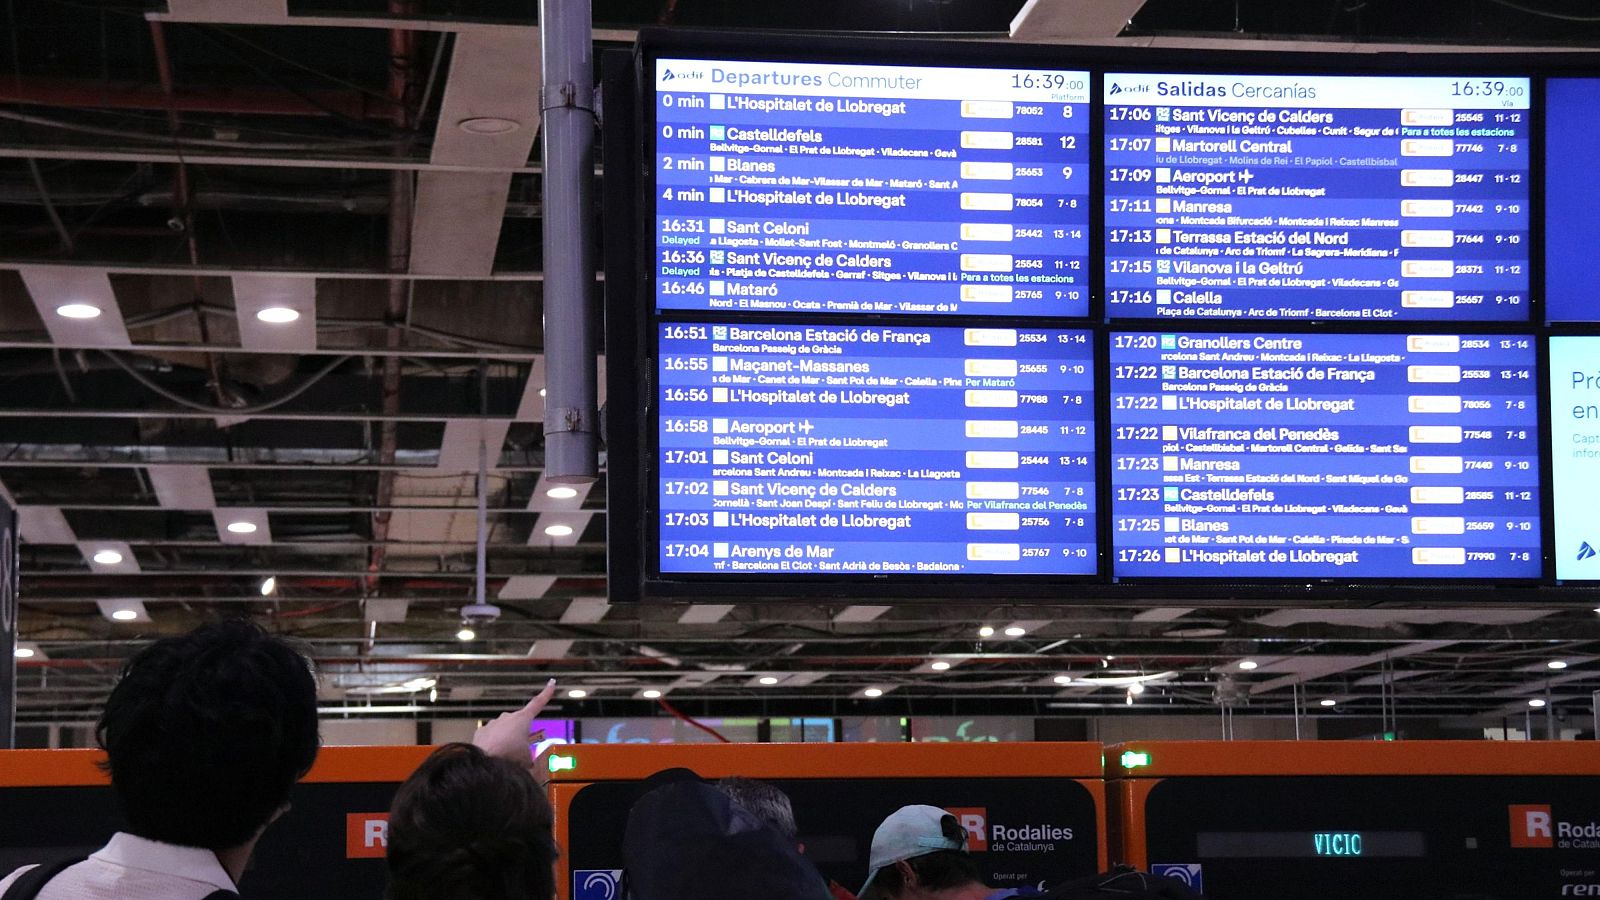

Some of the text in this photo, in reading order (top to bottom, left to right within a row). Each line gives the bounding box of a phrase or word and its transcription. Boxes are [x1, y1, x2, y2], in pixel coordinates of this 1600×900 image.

[711, 68, 823, 86] Departures
[828, 72, 922, 90] Commuter
[1157, 82, 1226, 97] Salidas
[1232, 82, 1317, 99] Cercanías
[663, 95, 1072, 118] 0 min L'Hospitalet de Llobregat 78052 8
[1111, 108, 1333, 125] 17:06 Sant Vicenç de Calders
[663, 126, 1075, 148] 0 min Castelldefels 12
[1401, 128, 1514, 137] Para a totes les estacions
[790, 145, 798, 153] El
[800, 146, 818, 154] Prat
[820, 146, 831, 154] de
[833, 147, 875, 157] Llobregat
[881, 148, 928, 157] Viladecans
[1111, 138, 1292, 153] 17:07 Martorell Central
[1180, 155, 1398, 167] Llobregat Molins de Rei Castellbisbal
[663, 157, 1072, 179] 2 min Blanes 25653 9
[1111, 169, 1235, 185] 17:09 Aeroport
[1111, 200, 1232, 213] 17:11 Manresa
[663, 219, 1042, 237] 16:31 Sant Celoni 25442
[662, 236, 700, 246] Delayed
[1111, 230, 1348, 244] 17:13 Terrassa Estació del Nord
[663, 251, 891, 268] 16:36 Sant Vicenç de Calders
[662, 266, 700, 277] Delayed
[1111, 261, 1303, 274] 17:15 Vilanova i la Geltrú
[960, 272, 1074, 283] Para a totes les estacions
[663, 282, 704, 294] 16:46
[727, 283, 777, 296] Mataró
[1111, 291, 1151, 303] 17:16
[1174, 292, 1222, 304] Calella
[1157, 307, 1181, 317] Plaça
[1197, 308, 1242, 317] Catalunya
[665, 327, 1047, 345] 16:51 Barcelona Estació de França 25534
[1116, 336, 1302, 349] 17:20 Granollers Centre
[713, 344, 842, 354] Barcelona Passeig de Gràcia
[665, 358, 708, 370] 16:55
[731, 359, 869, 374] Maçanet-Massanes
[966, 378, 1015, 387] Per Mataró
[666, 389, 909, 406] 16:56 L'Hospitalet de Llobregat
[666, 420, 795, 436] 16:58 Aeroport
[1117, 427, 1339, 440] 17:22 Vilafranca del Penedès
[666, 451, 708, 463] 17:01
[731, 451, 762, 464] Sant
[767, 452, 813, 464] Celoni
[1118, 488, 1274, 501] 17:23 Castelldefels
[967, 501, 1087, 510] Per Vilafranca del Penedès
[1119, 519, 1229, 531] 17:25 Blanes
[666, 544, 834, 560] 17:04 Arenys de Mar
[961, 814, 986, 841] R
[1526, 812, 1550, 837] R
[992, 824, 1073, 840] Rodalies
[992, 842, 1054, 852] de Catalunya
[1558, 839, 1570, 848] de
[994, 872, 1027, 881] Operat per
[1583, 870, 1595, 878] per
